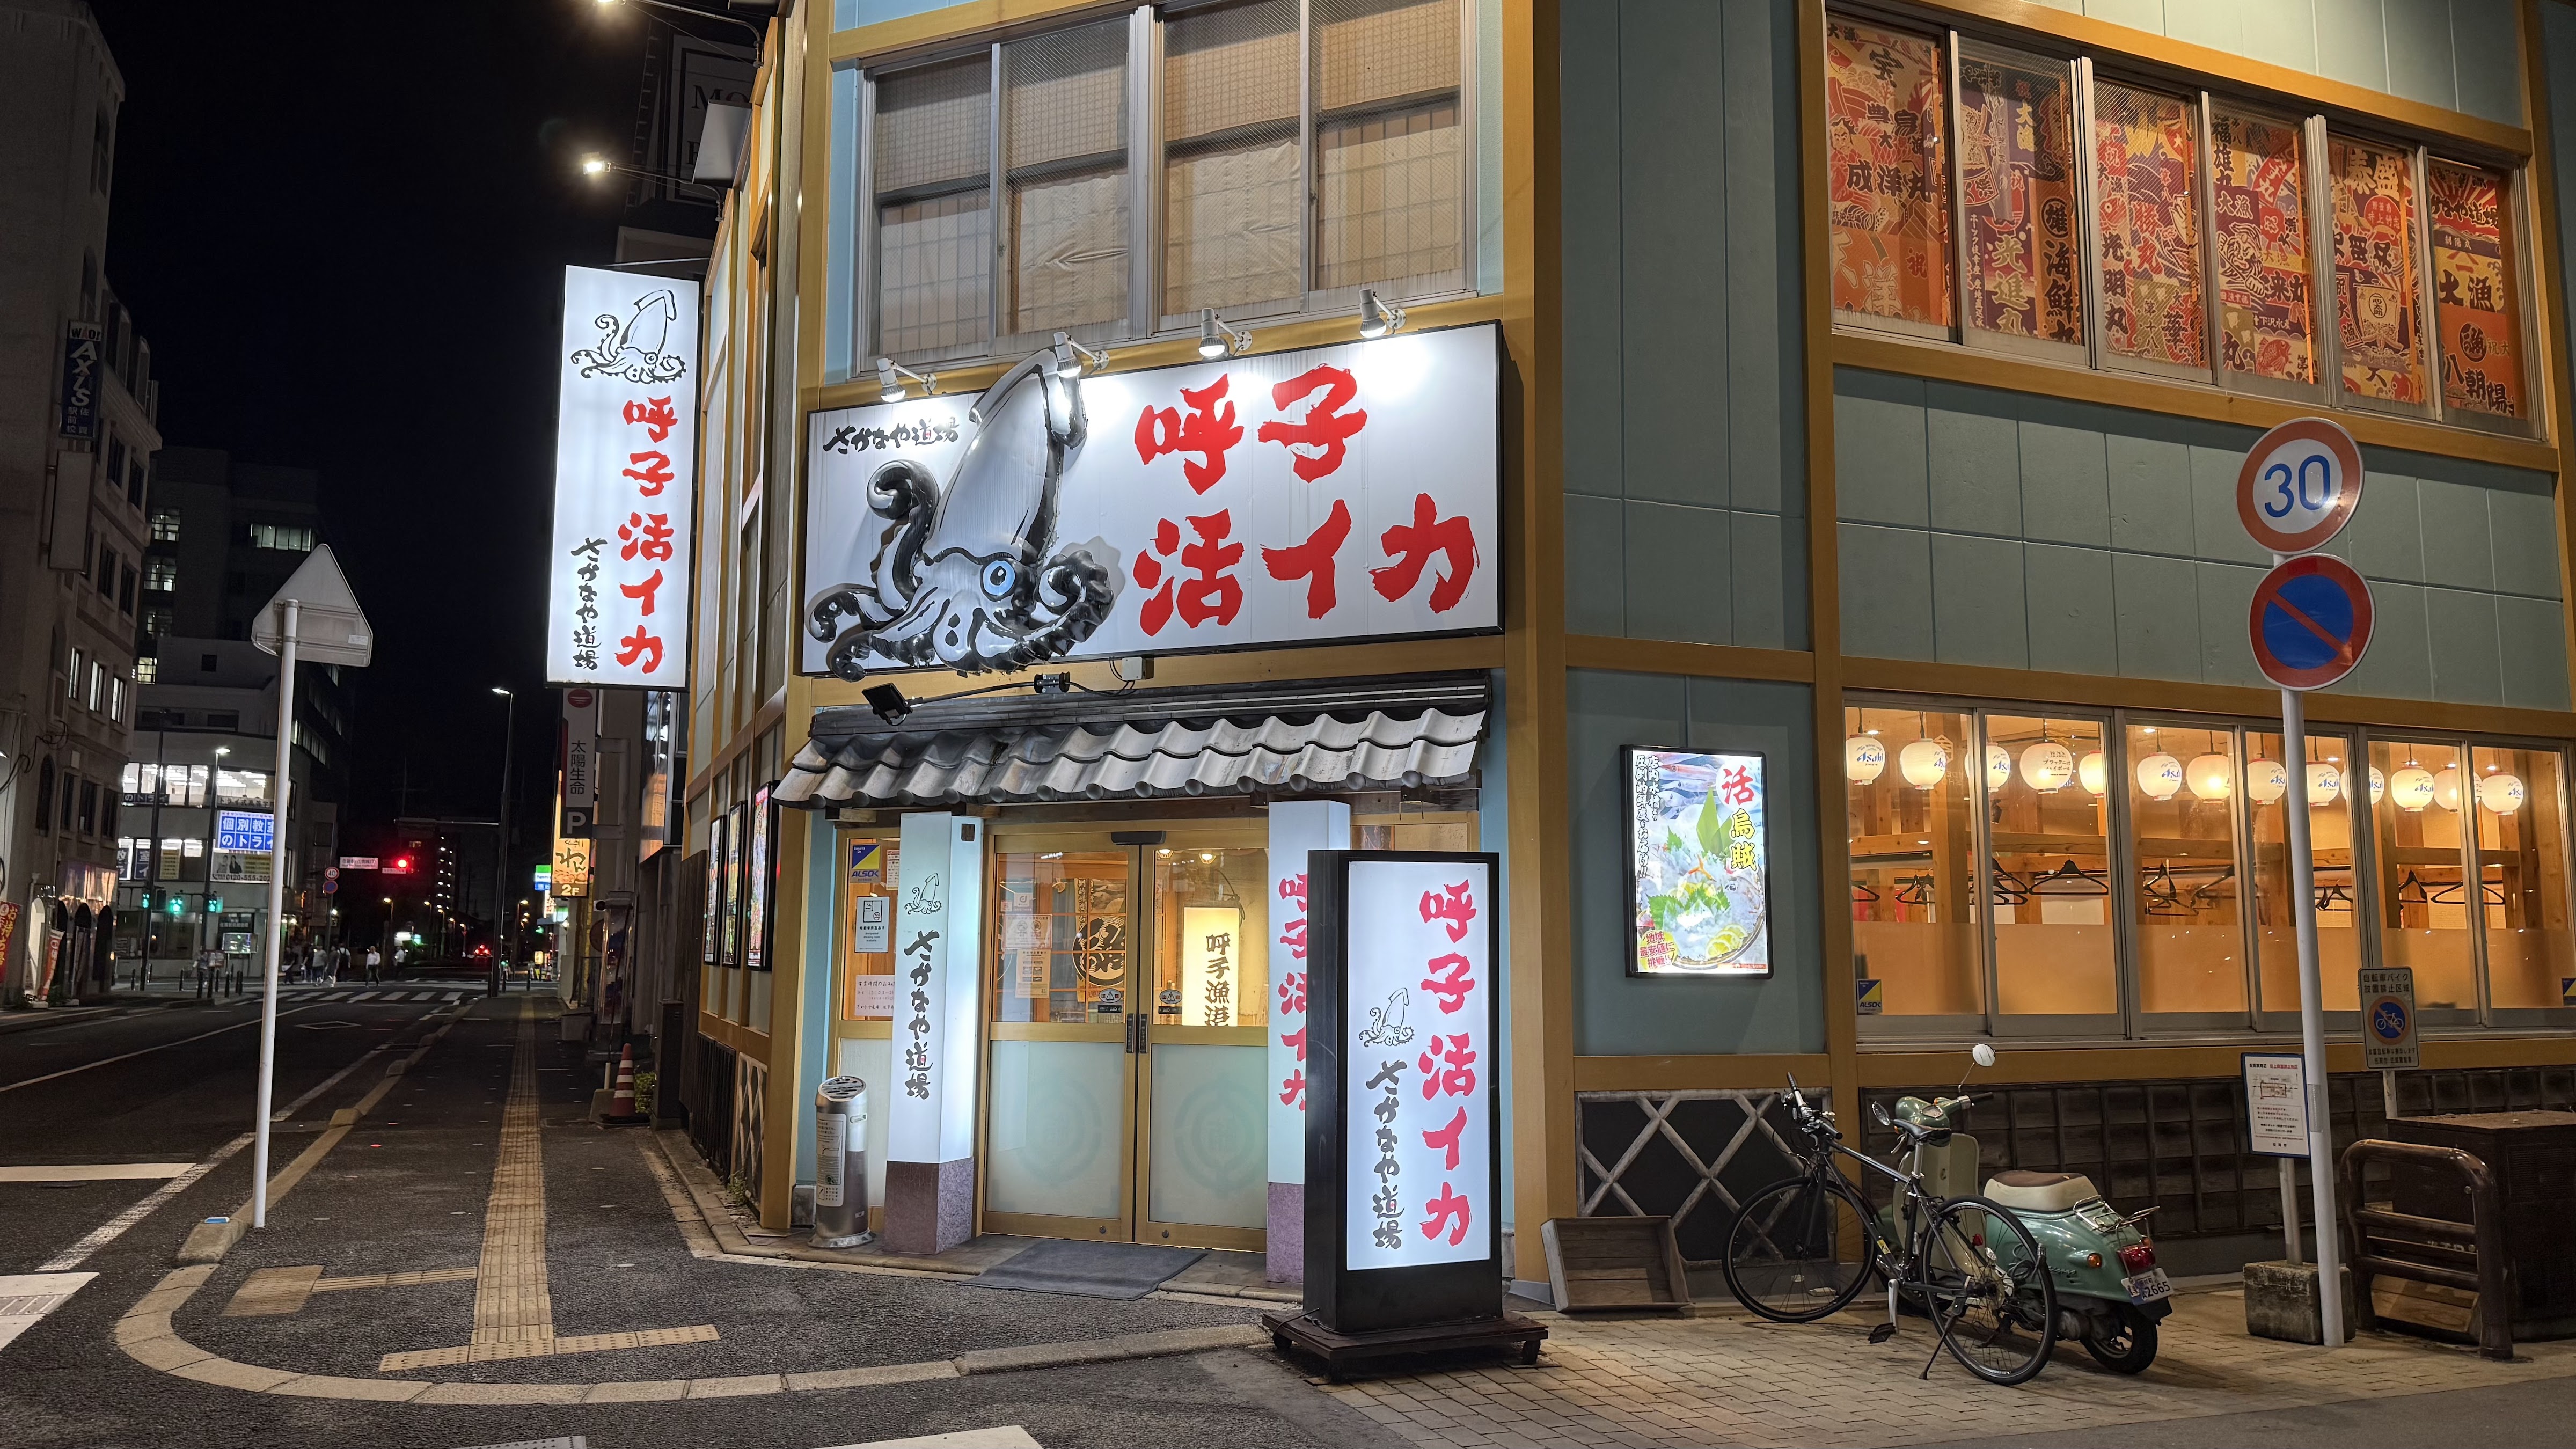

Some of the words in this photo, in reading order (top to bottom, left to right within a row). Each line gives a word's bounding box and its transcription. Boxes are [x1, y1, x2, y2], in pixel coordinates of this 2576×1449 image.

[2015, 100, 2037, 152] 大漁
[1846, 160, 1934, 204] 成洋丸
[2218, 190, 2253, 219] 大漁
[1992, 235, 2030, 335] 光進丸
[2102, 231, 2129, 335] 光明丸
[2439, 269, 2496, 313] 大漁
[71, 325, 101, 340] WAO!
[70, 341, 97, 407] AXIS
[823, 416, 960, 455] さかなや道場
[1135, 363, 1367, 495] 呼子
[2264, 455, 2331, 518] 30
[614, 396, 678, 675] 呼子活イカ
[1133, 493, 1480, 637] 活イカ
[570, 537, 608, 671] さかなや道場
[570, 740, 587, 795] 太陽生命
[221, 834, 273, 848] のトライ
[567, 811, 587, 835] P
[561, 884, 580, 896] 2F
[1204, 932, 1231, 1027] 呼子漁港
[2363, 974, 2409, 982] 自転車バイク
[904, 929, 940, 1100] さかなや道場
[1418, 879, 1478, 1248] 呼子活イカ
[1366, 1059, 1408, 1250] さかなや道場
[2147, 1281, 2170, 1297] 2665
